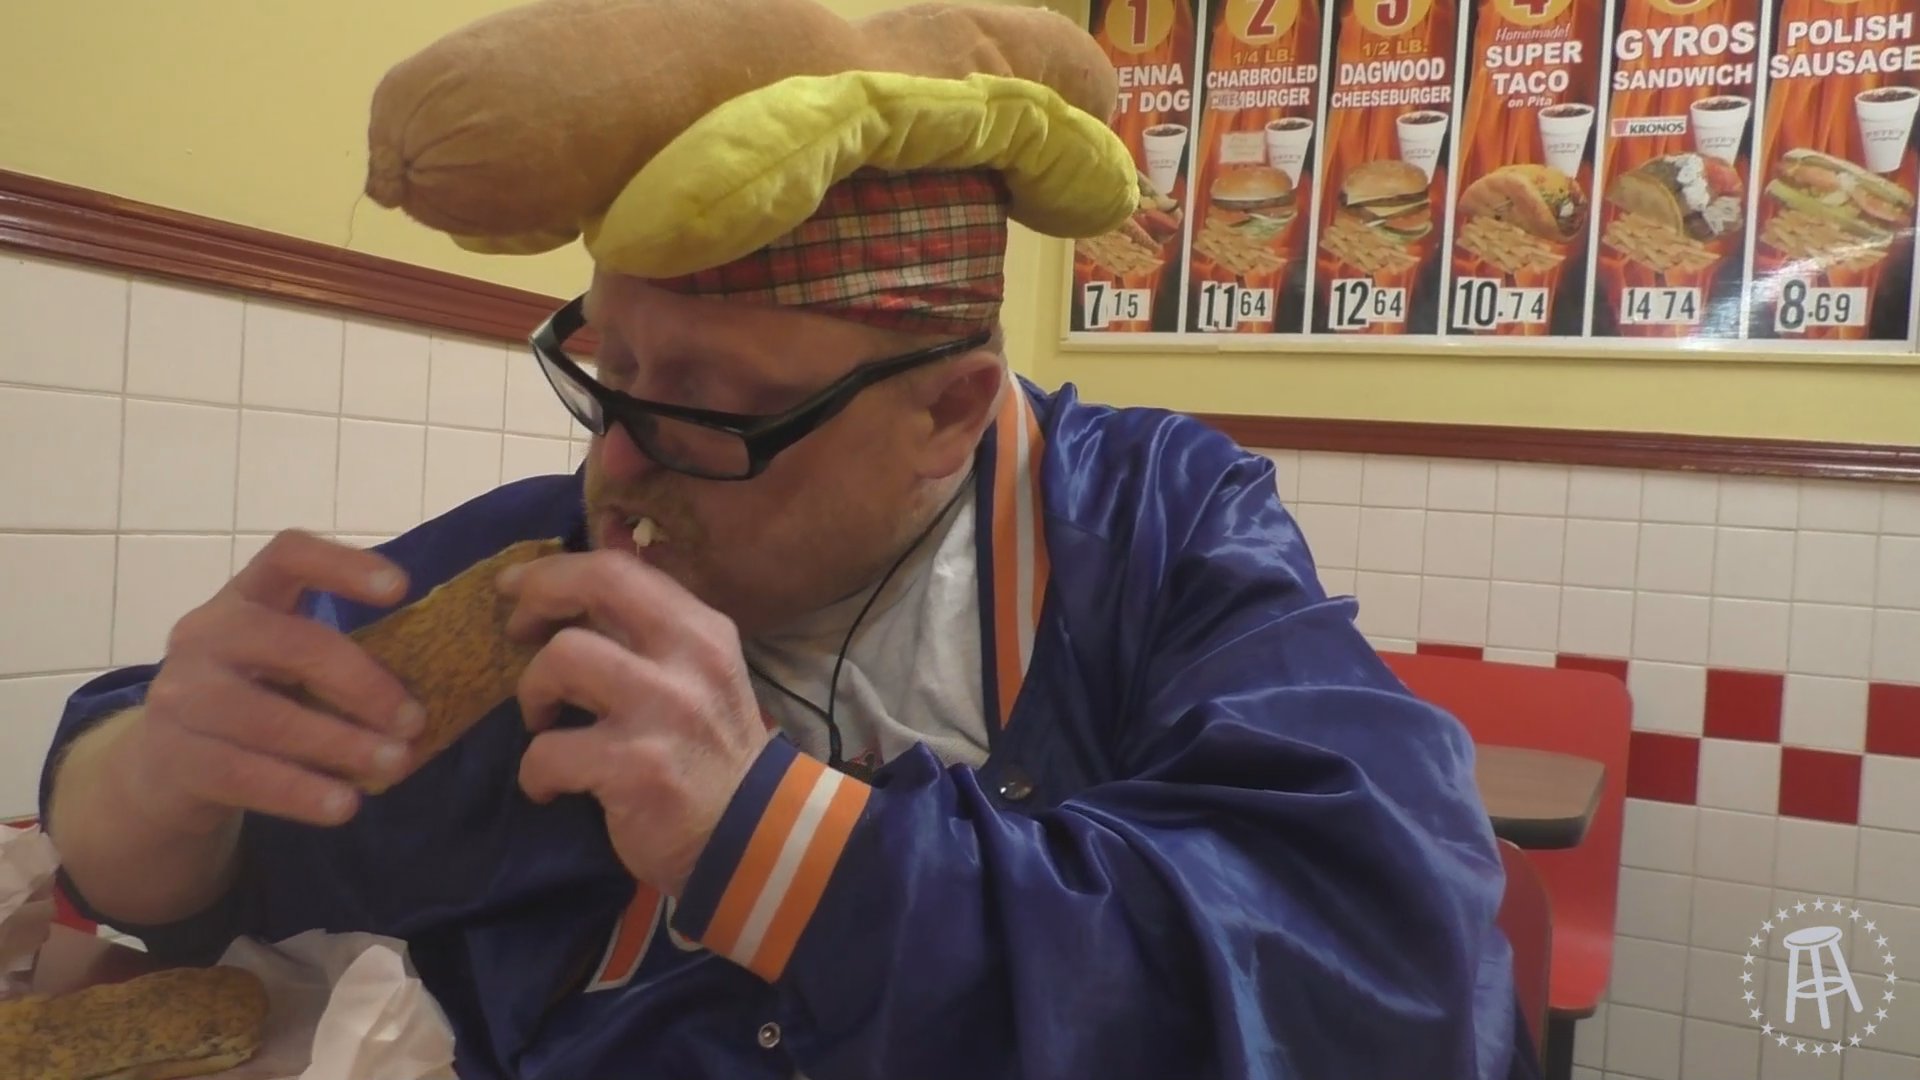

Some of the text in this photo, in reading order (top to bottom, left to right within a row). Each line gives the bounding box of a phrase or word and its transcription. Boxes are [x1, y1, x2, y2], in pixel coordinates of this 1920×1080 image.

[1496, 23, 1571, 41] Homemade!
[1615, 21, 1756, 60] GYROS
[1787, 12, 1914, 47] POLISH
[1233, 48, 1295, 65] 1/4 LB.
[1363, 39, 1428, 57] 1/2 LB.
[1485, 40, 1583, 68] SUPER
[1340, 58, 1446, 85] DAGWOOD
[1770, 45, 1920, 79] SAUSAGE
[1206, 64, 1318, 89] CHARBROILED
[1492, 70, 1569, 95] TACO
[1613, 63, 1754, 90] SANDWICH
[1139, 90, 1191, 113] DOG
[1332, 86, 1451, 108] CHEESEBURGER
[1508, 96, 1553, 109] on Pita
[1629, 122, 1684, 135] KRONOS
[1780, 279, 1850, 329] 8.69
